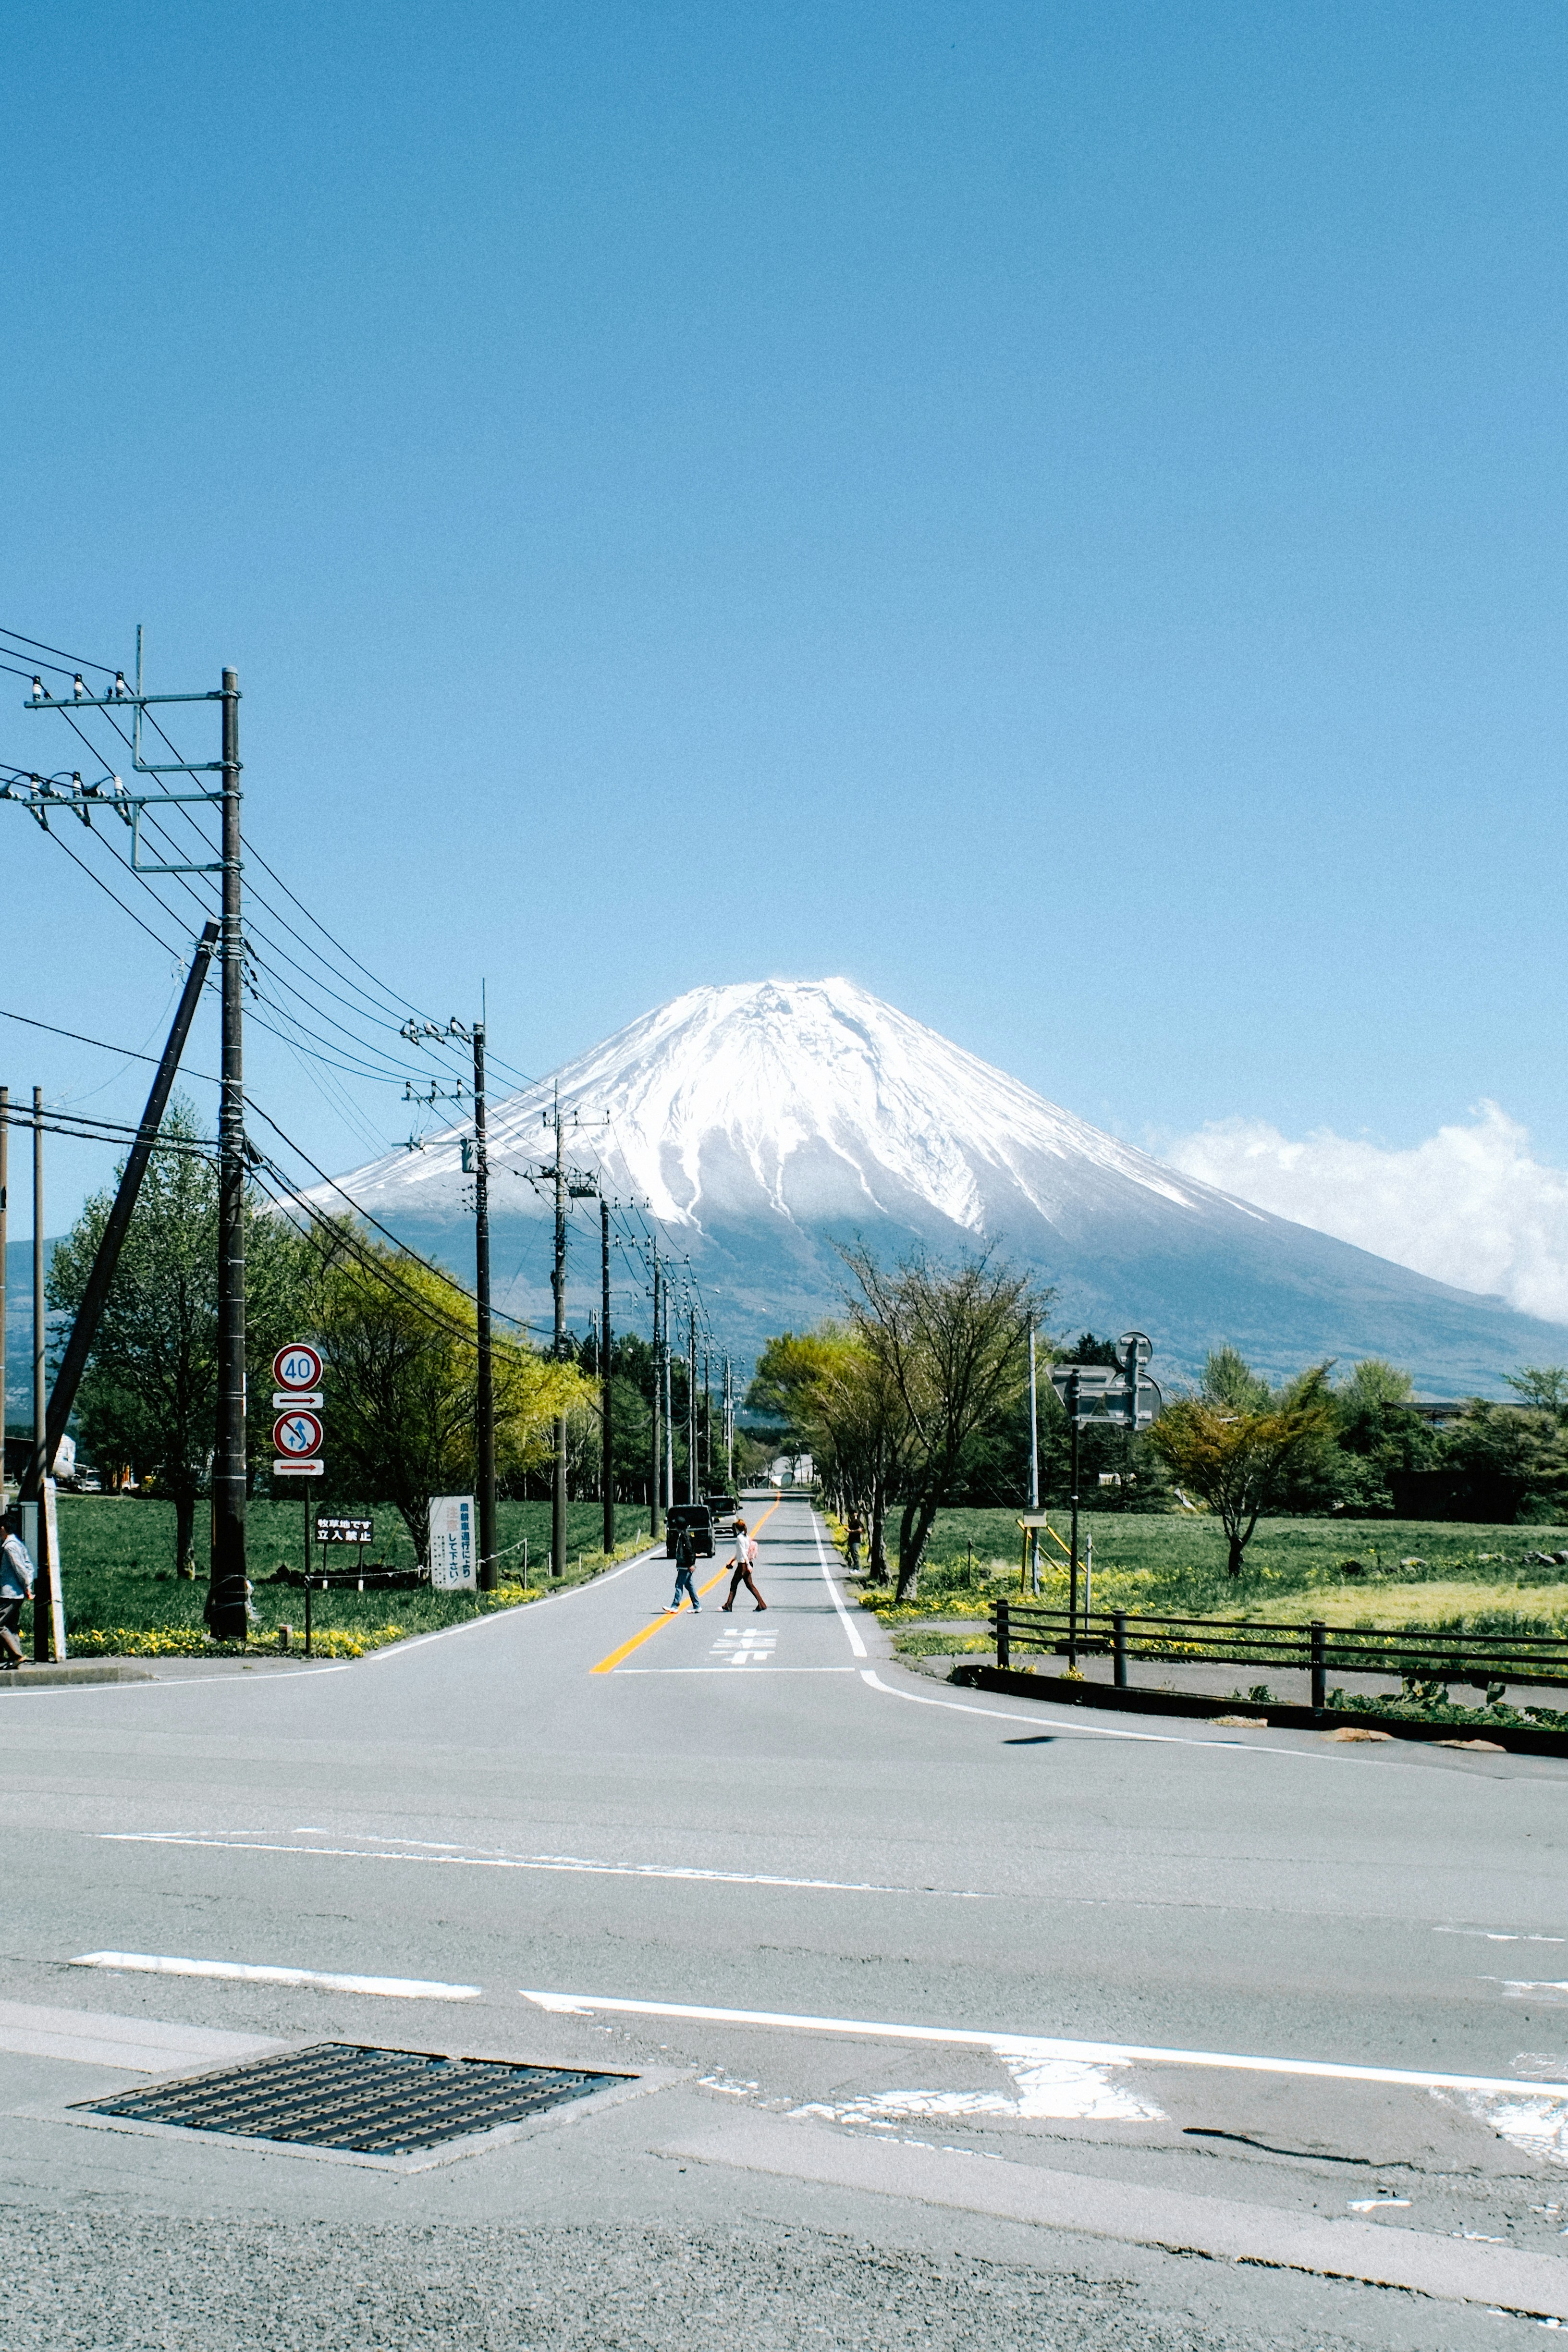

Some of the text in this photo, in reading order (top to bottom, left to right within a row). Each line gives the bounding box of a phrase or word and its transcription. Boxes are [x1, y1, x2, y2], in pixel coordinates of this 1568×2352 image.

[285, 1359, 310, 1379] 40
[317, 1519, 372, 1530] 牧草地です
[317, 1529, 371, 1542] 立入禁止
